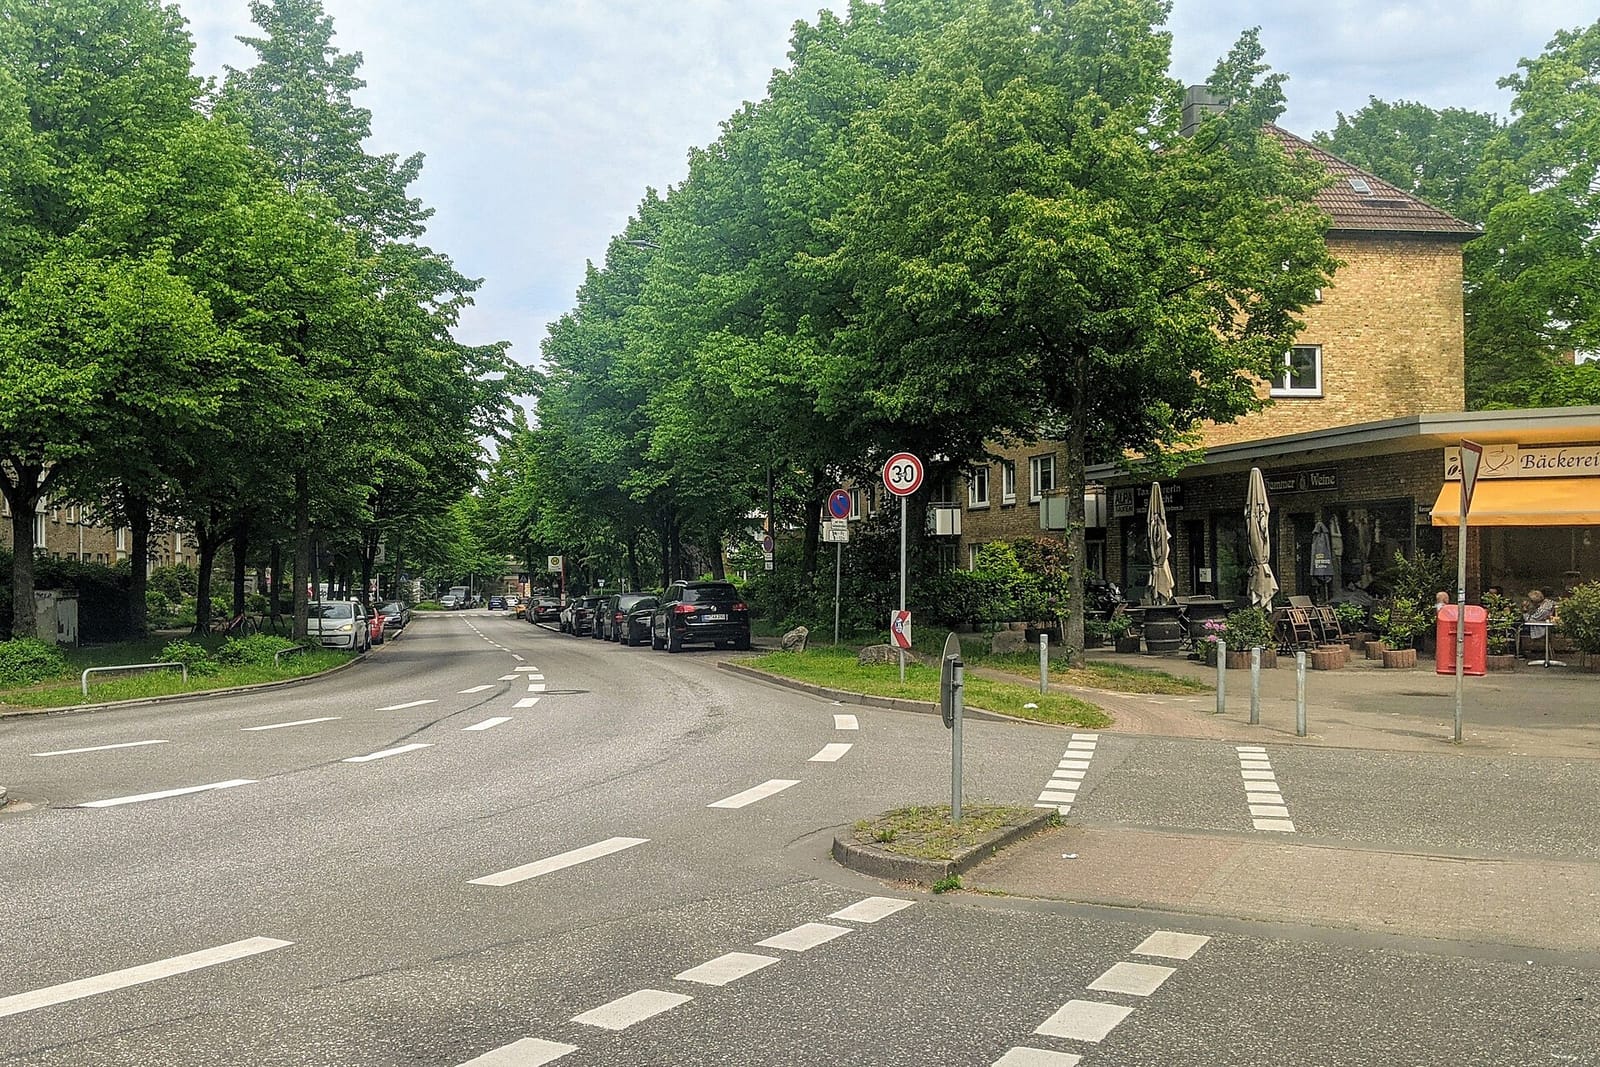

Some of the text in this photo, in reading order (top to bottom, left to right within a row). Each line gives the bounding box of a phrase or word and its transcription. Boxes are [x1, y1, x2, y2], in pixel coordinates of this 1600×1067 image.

[1520, 449, 1600, 470] Bäckerei
[891, 464, 914, 483] 30
[1310, 472, 1336, 487] Weine
